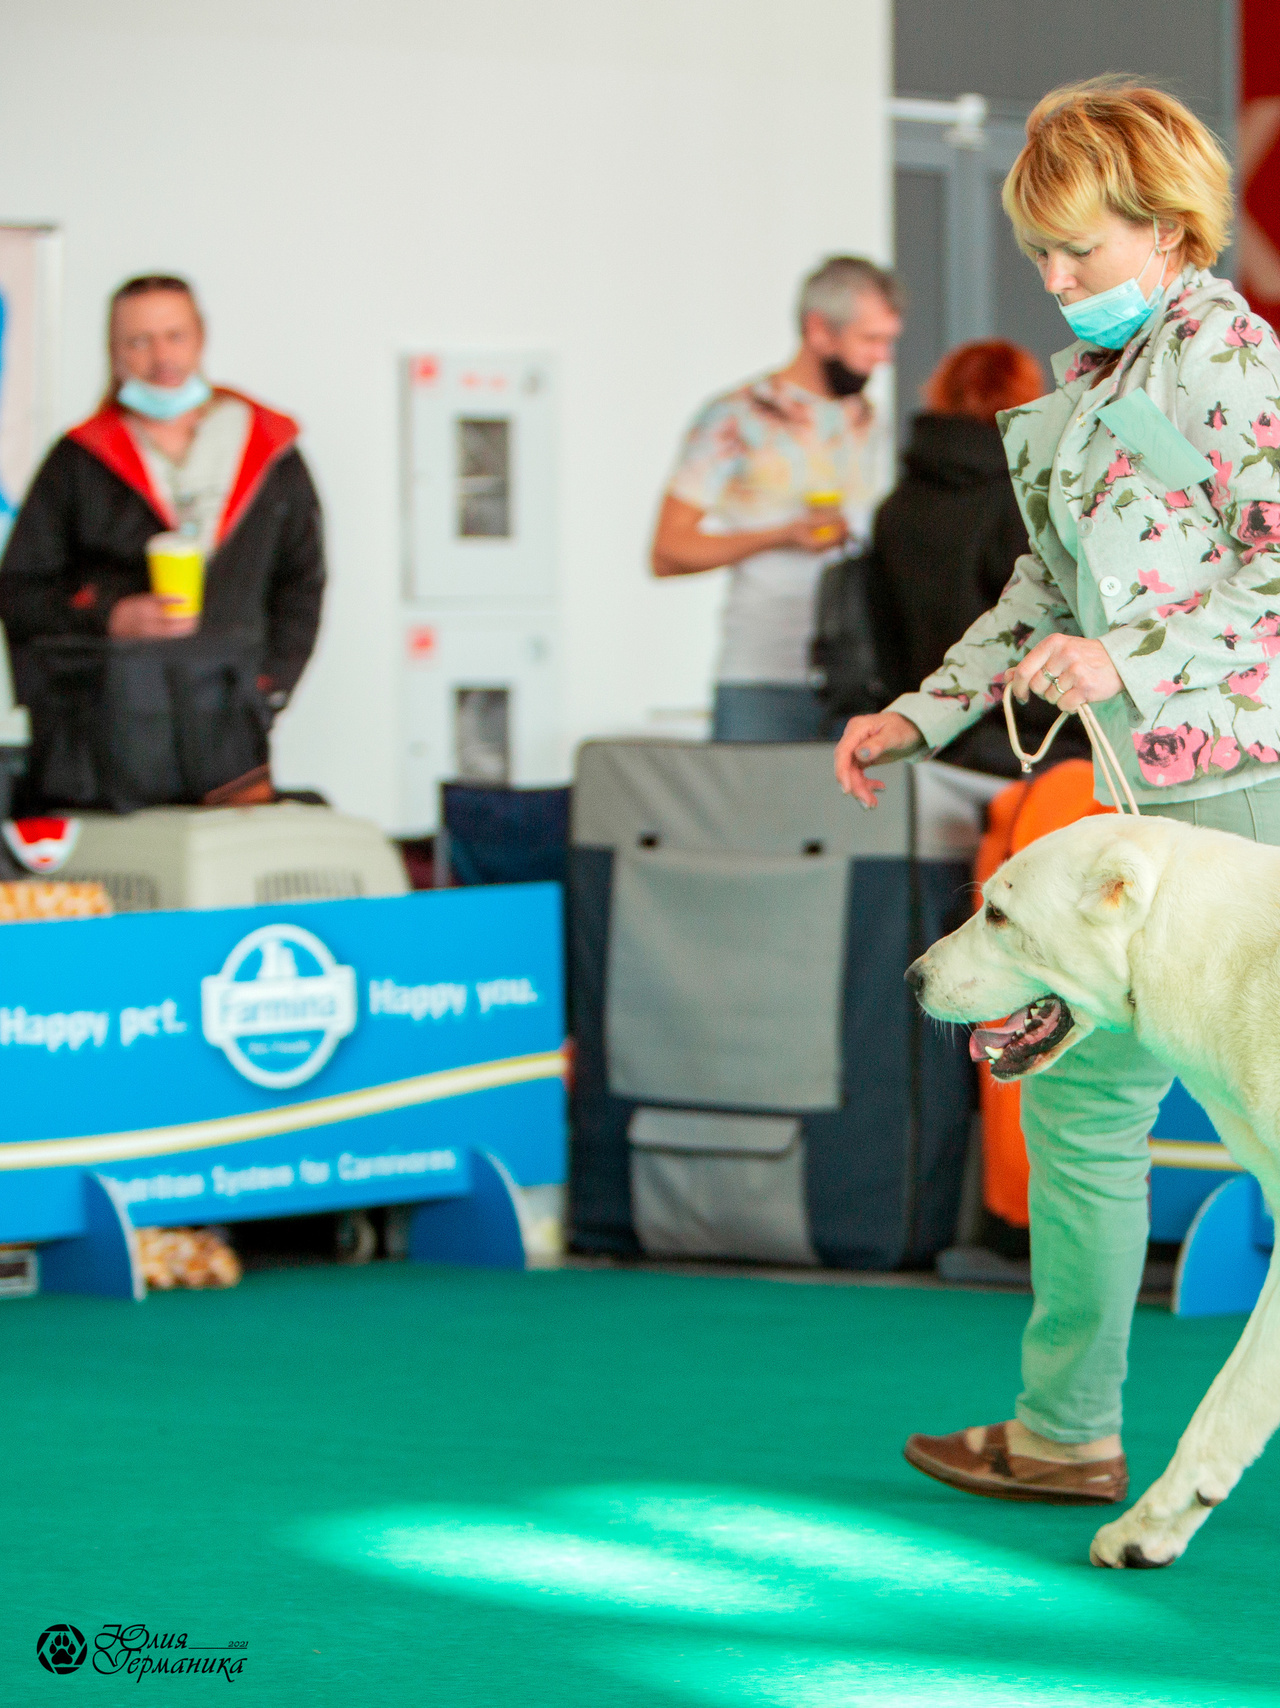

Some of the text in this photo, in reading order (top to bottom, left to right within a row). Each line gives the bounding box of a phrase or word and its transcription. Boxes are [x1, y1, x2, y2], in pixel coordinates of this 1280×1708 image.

[369, 976, 539, 1019] Happy you.
[0, 1006, 109, 1053] Happy
